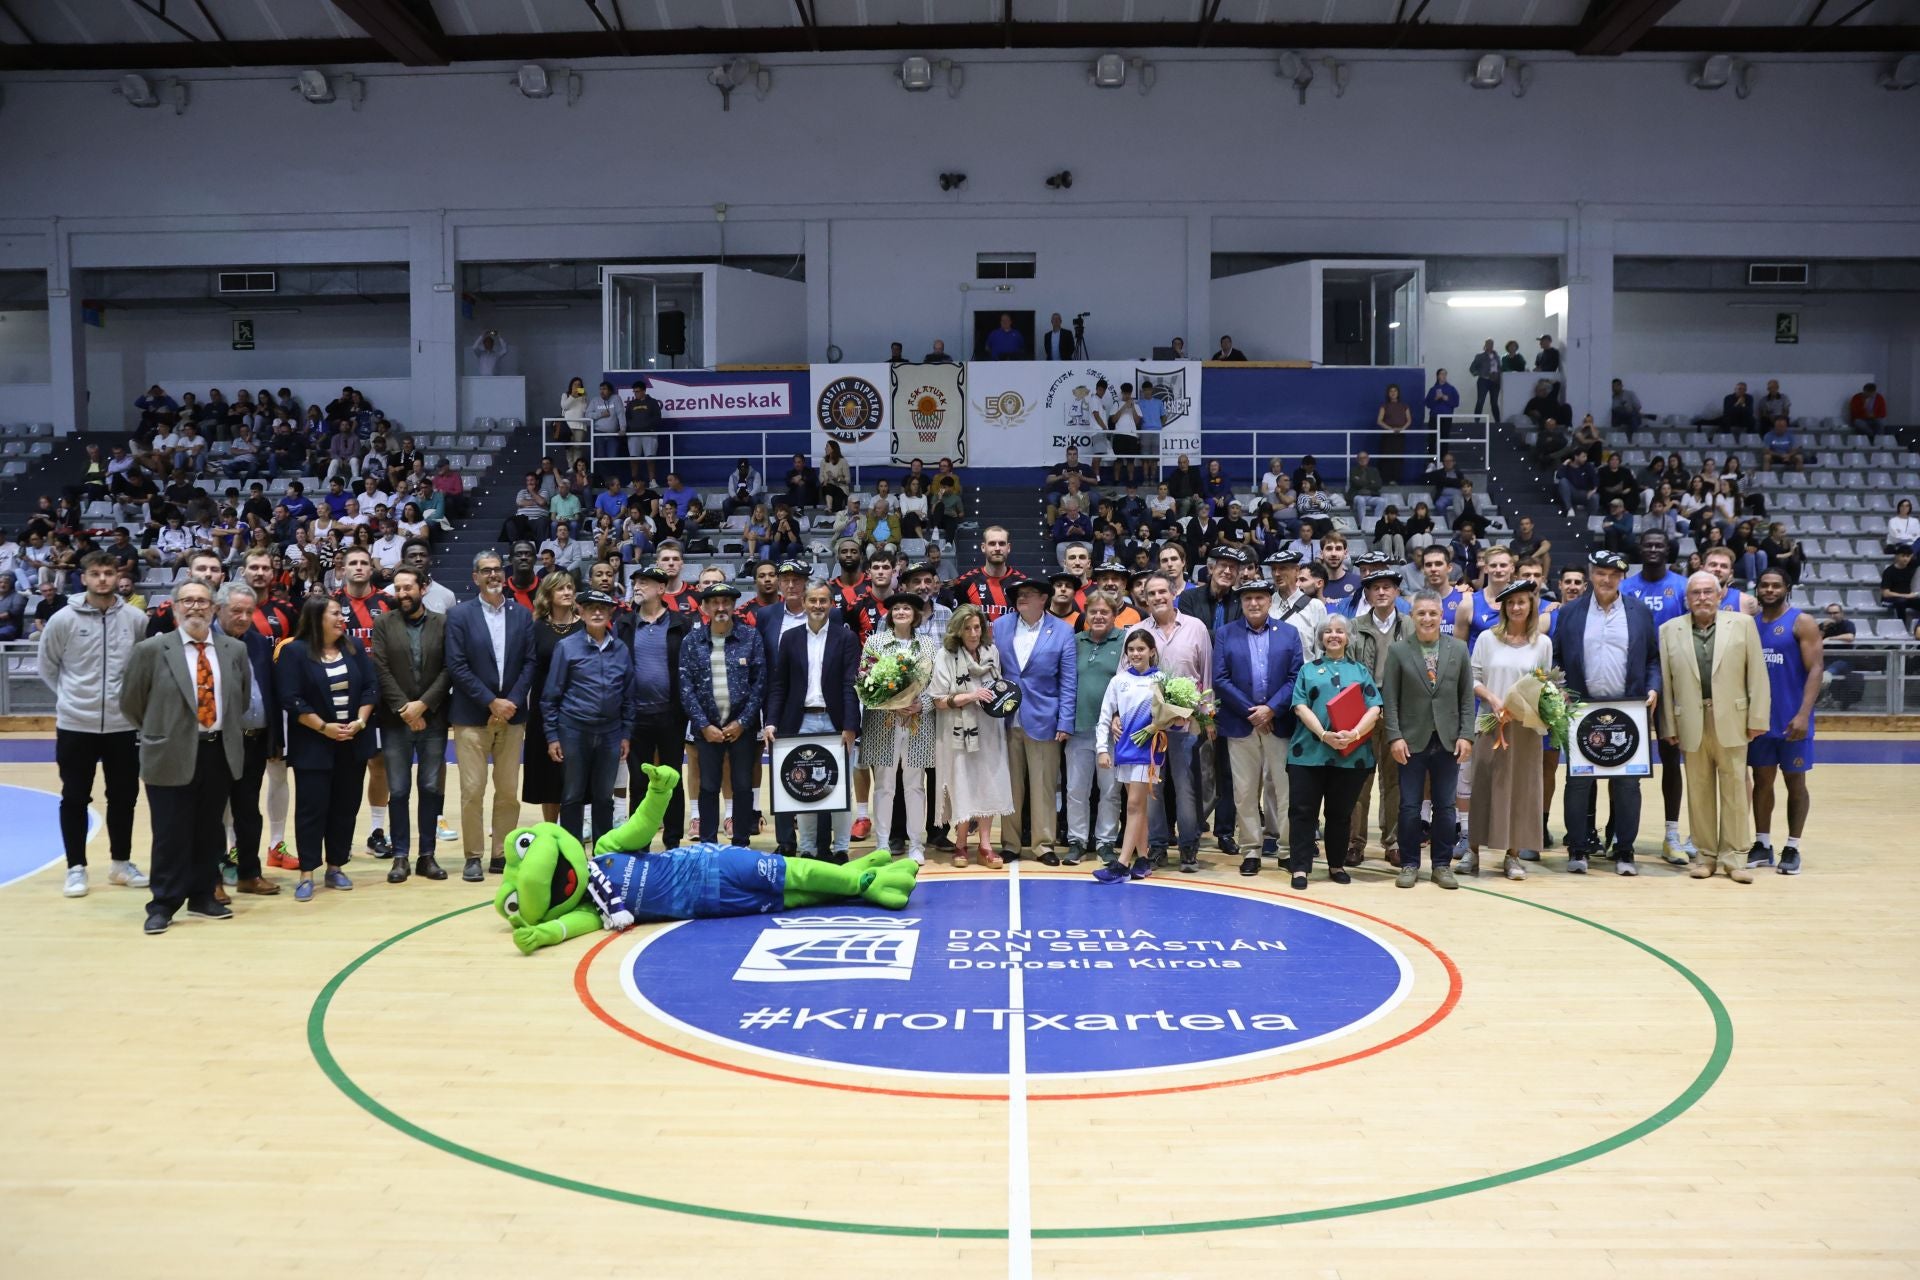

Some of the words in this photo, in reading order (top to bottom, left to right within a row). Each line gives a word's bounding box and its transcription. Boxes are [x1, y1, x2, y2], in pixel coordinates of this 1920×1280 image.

[822, 381, 846, 424] DONOSTIA
[854, 381, 880, 423] GIPUZKOA
[1644, 596, 1664, 611] 55
[949, 929, 1157, 940] DONOSTIA
[946, 941, 1032, 952] SAN
[1049, 939, 1289, 952] SEBASTIÁN
[948, 958, 1114, 970] Donostia
[1129, 957, 1243, 970] Kirola
[738, 1006, 1300, 1032] #KirolTxartela
